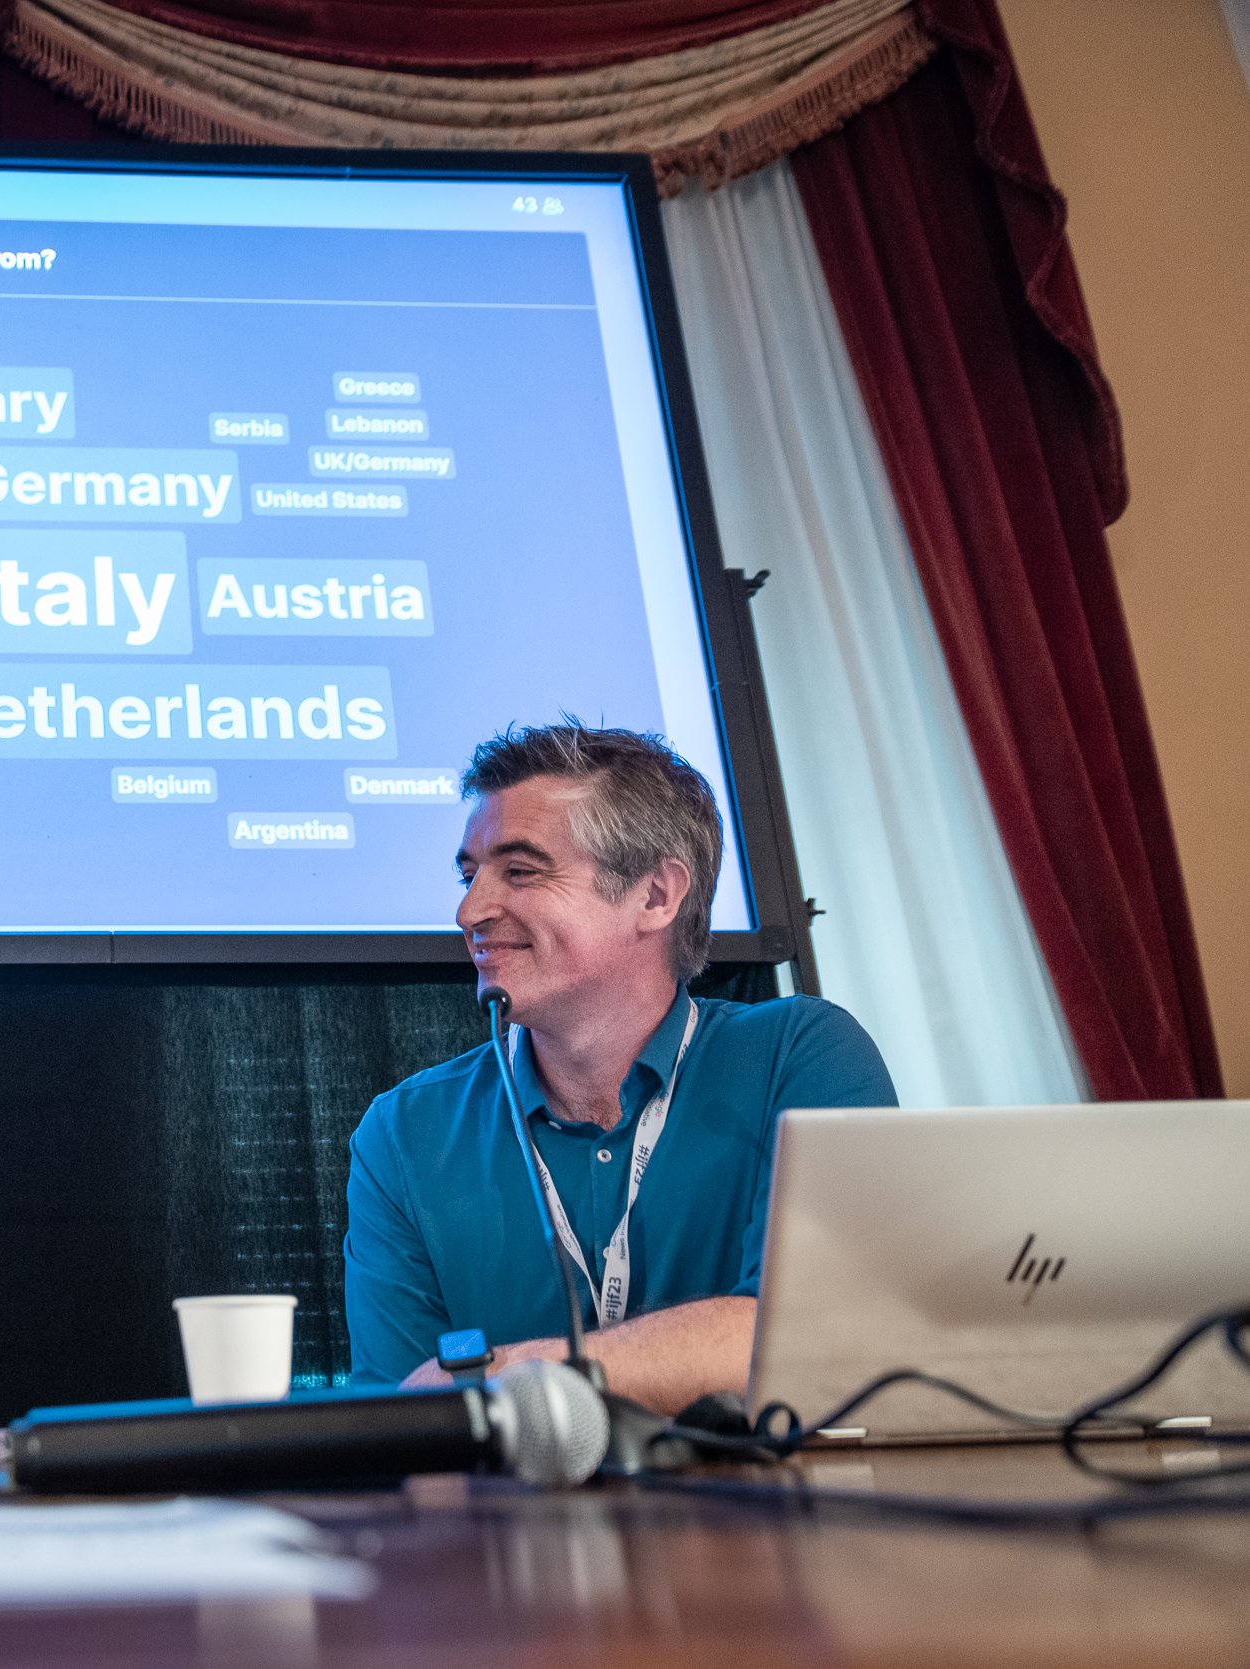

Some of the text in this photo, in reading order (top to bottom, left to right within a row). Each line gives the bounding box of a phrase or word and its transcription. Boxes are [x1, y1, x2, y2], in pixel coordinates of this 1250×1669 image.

[513, 197, 538, 212] 43
[339, 378, 415, 396] Greece
[215, 419, 283, 437] Serbia
[332, 415, 423, 433] Lebanon
[315, 453, 450, 475] UK/Germany
[256, 490, 402, 509] United States
[208, 574, 424, 619] Austria
[118, 775, 211, 798] Belgium
[351, 776, 454, 794] Denmark
[235, 820, 348, 844] Argentina
[634, 1144, 651, 1186] #ijf23
[606, 1276, 622, 1320] #ijf23
